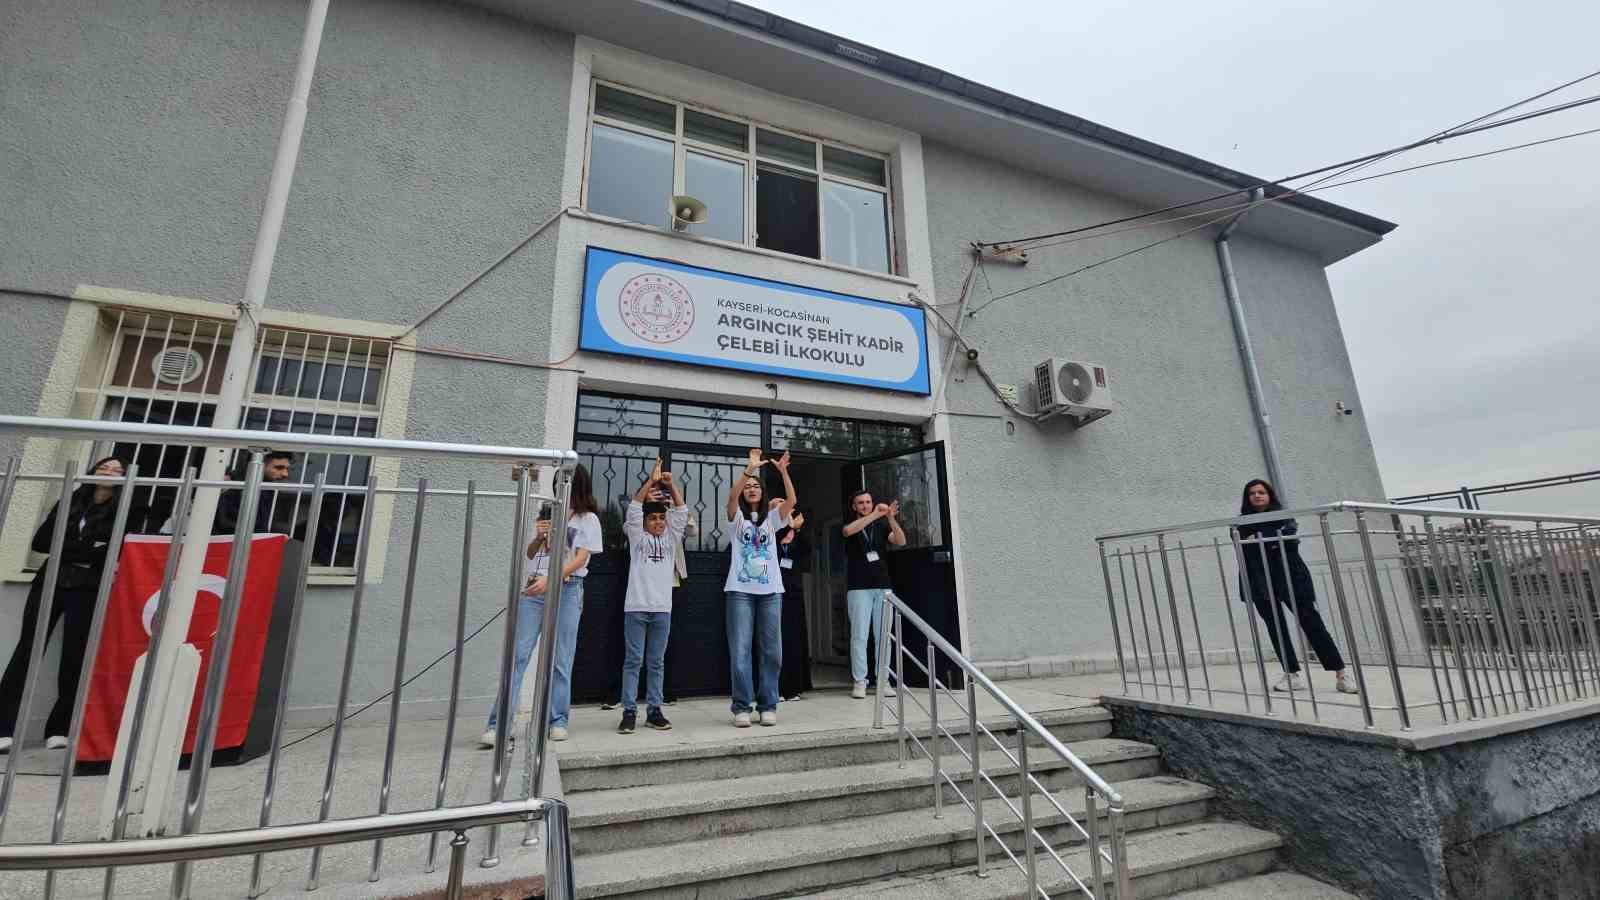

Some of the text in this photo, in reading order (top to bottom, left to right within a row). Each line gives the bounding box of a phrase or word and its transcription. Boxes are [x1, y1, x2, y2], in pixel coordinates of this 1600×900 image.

[717, 298, 830, 325] KAYSERİ-KOCASİNAN
[717, 313, 904, 353] ARGINCIK ŞEHİT KADİR
[717, 334, 865, 367] ÇELEBİ İLKOKULU
